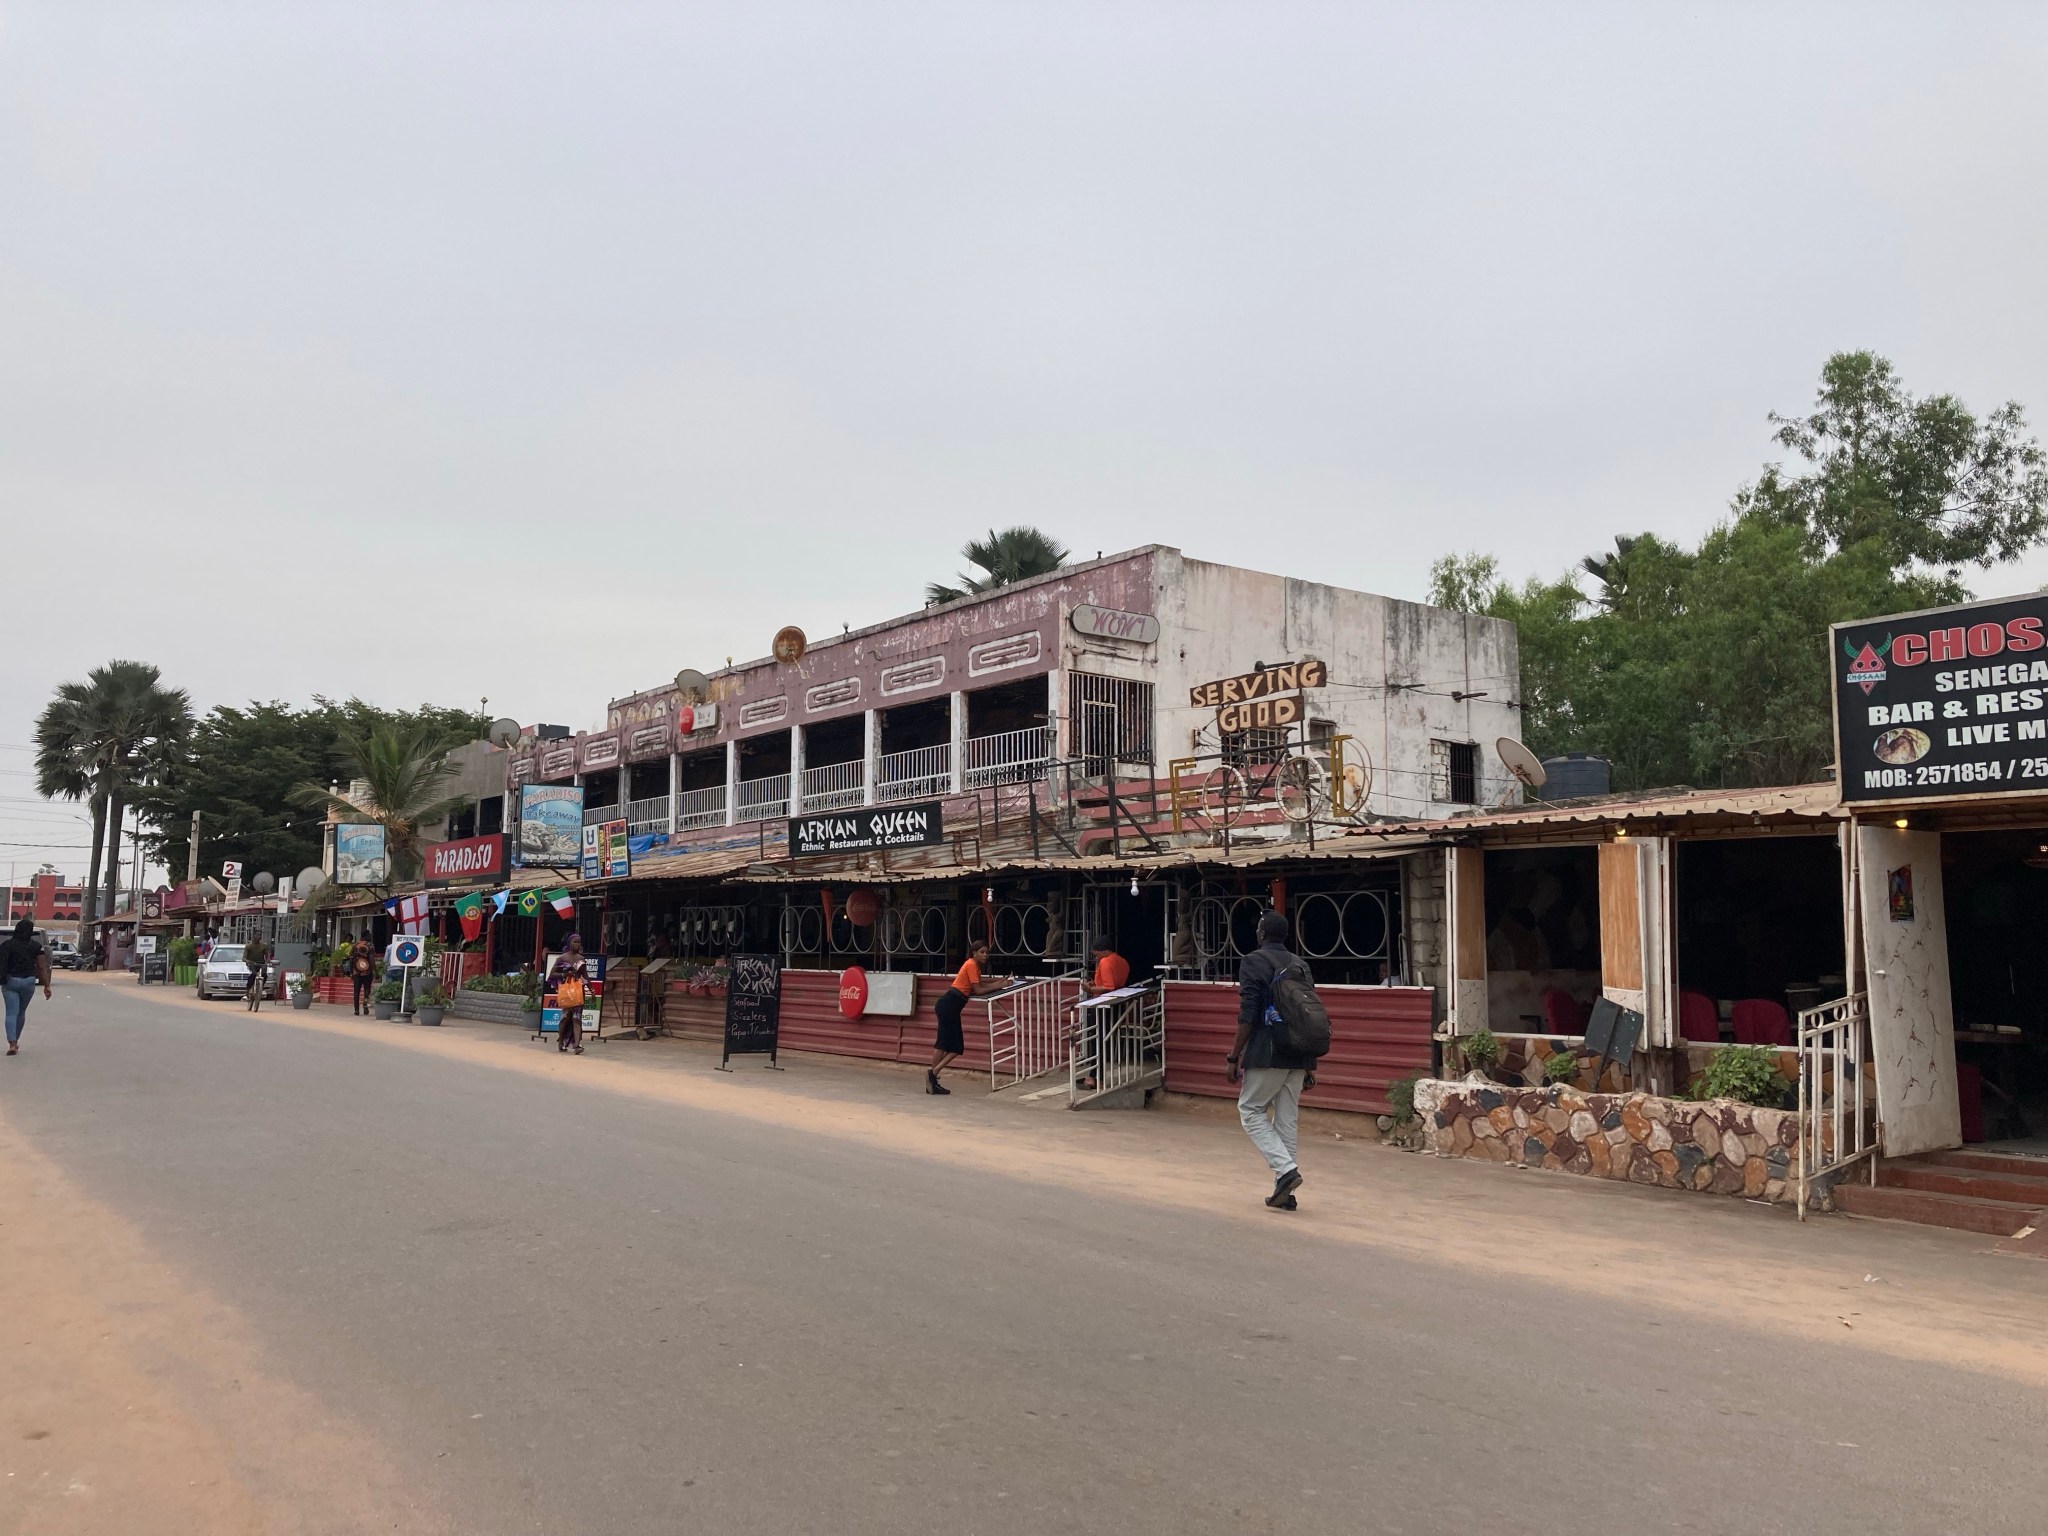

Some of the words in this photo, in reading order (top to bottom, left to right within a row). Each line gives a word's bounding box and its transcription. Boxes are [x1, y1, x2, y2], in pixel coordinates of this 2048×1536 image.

[1892, 617, 2048, 667] CHOS
[1192, 661, 1321, 708] SERVING
[1848, 673, 1885, 681] CHOSAAN
[1219, 699, 1296, 732] GOOD
[1868, 700, 1934, 726] BAR
[1943, 700, 1968, 719] &
[1976, 687, 2048, 716] RES
[1947, 722, 2010, 747] LIVE
[2017, 719, 2048, 741] M
[1864, 768, 1913, 789] MOB:
[1916, 761, 2002, 786] 2571854
[523, 788, 582, 809] PARADISO
[524, 807, 581, 824] Takeaway
[869, 810, 927, 836] QUEEN
[801, 842, 825, 852] Ethnic
[829, 838, 872, 850] Restaurant
[876, 836, 883, 846] &
[884, 832, 925, 844] Cocktails
[734, 1011, 767, 1022] Sizzlers
